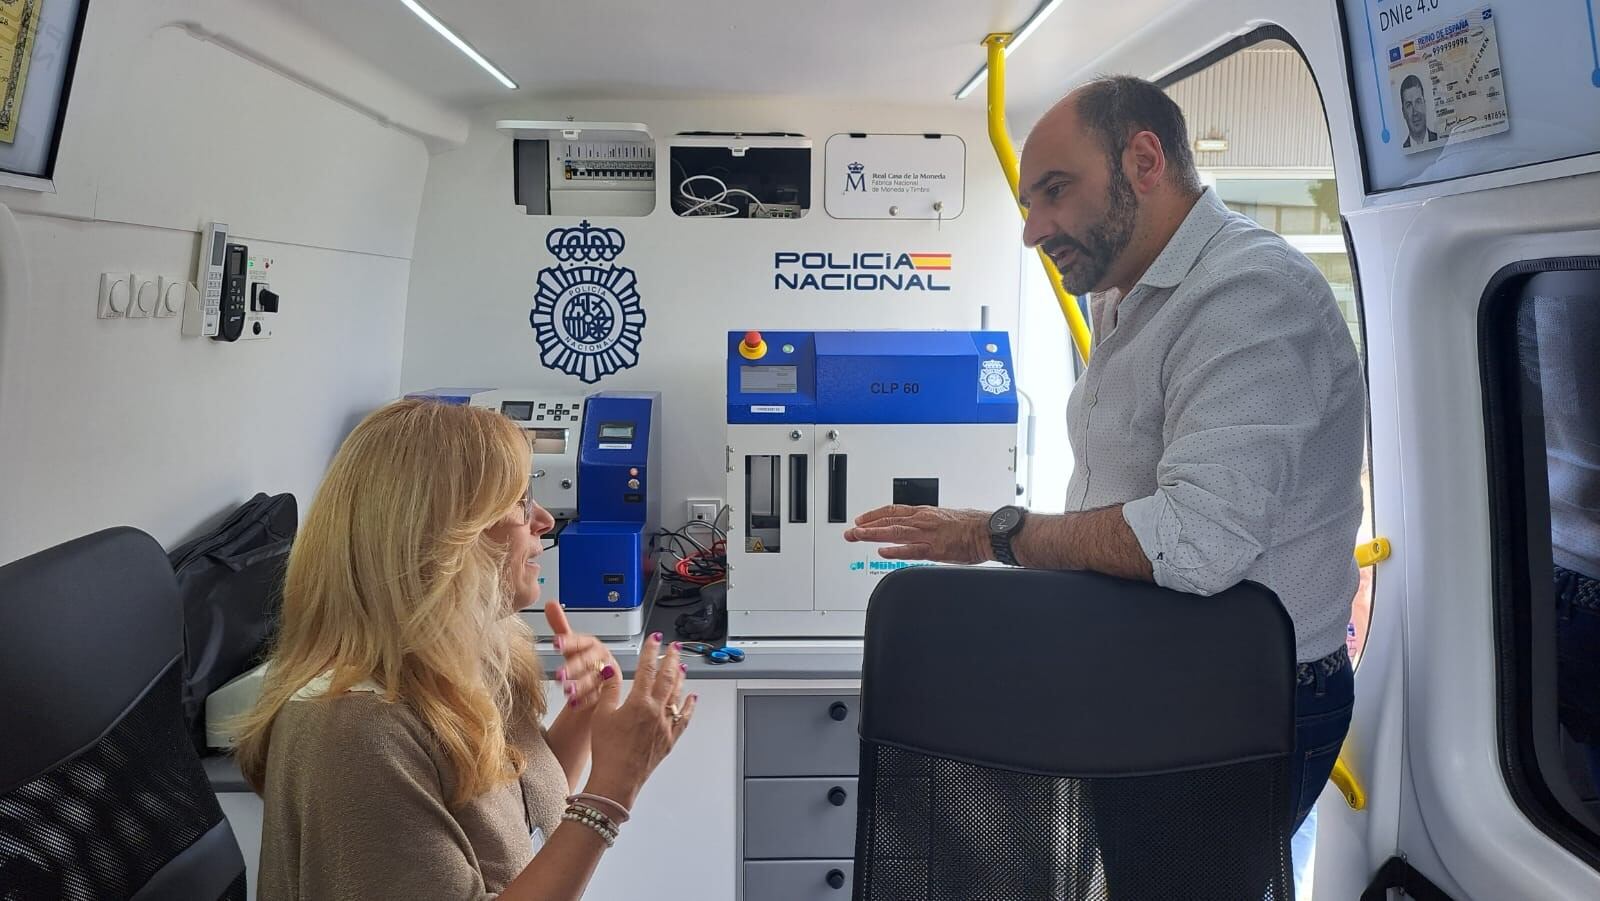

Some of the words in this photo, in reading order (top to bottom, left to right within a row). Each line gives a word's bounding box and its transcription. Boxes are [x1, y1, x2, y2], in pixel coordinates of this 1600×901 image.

[1379, 4, 1413, 32] DNIe
[872, 172, 887, 180] Real
[912, 172, 919, 180] la
[774, 273, 951, 291] NACIONAL
[565, 336, 614, 352] NACIONAL
[870, 382, 899, 394] CLP
[903, 382, 920, 394] 60
